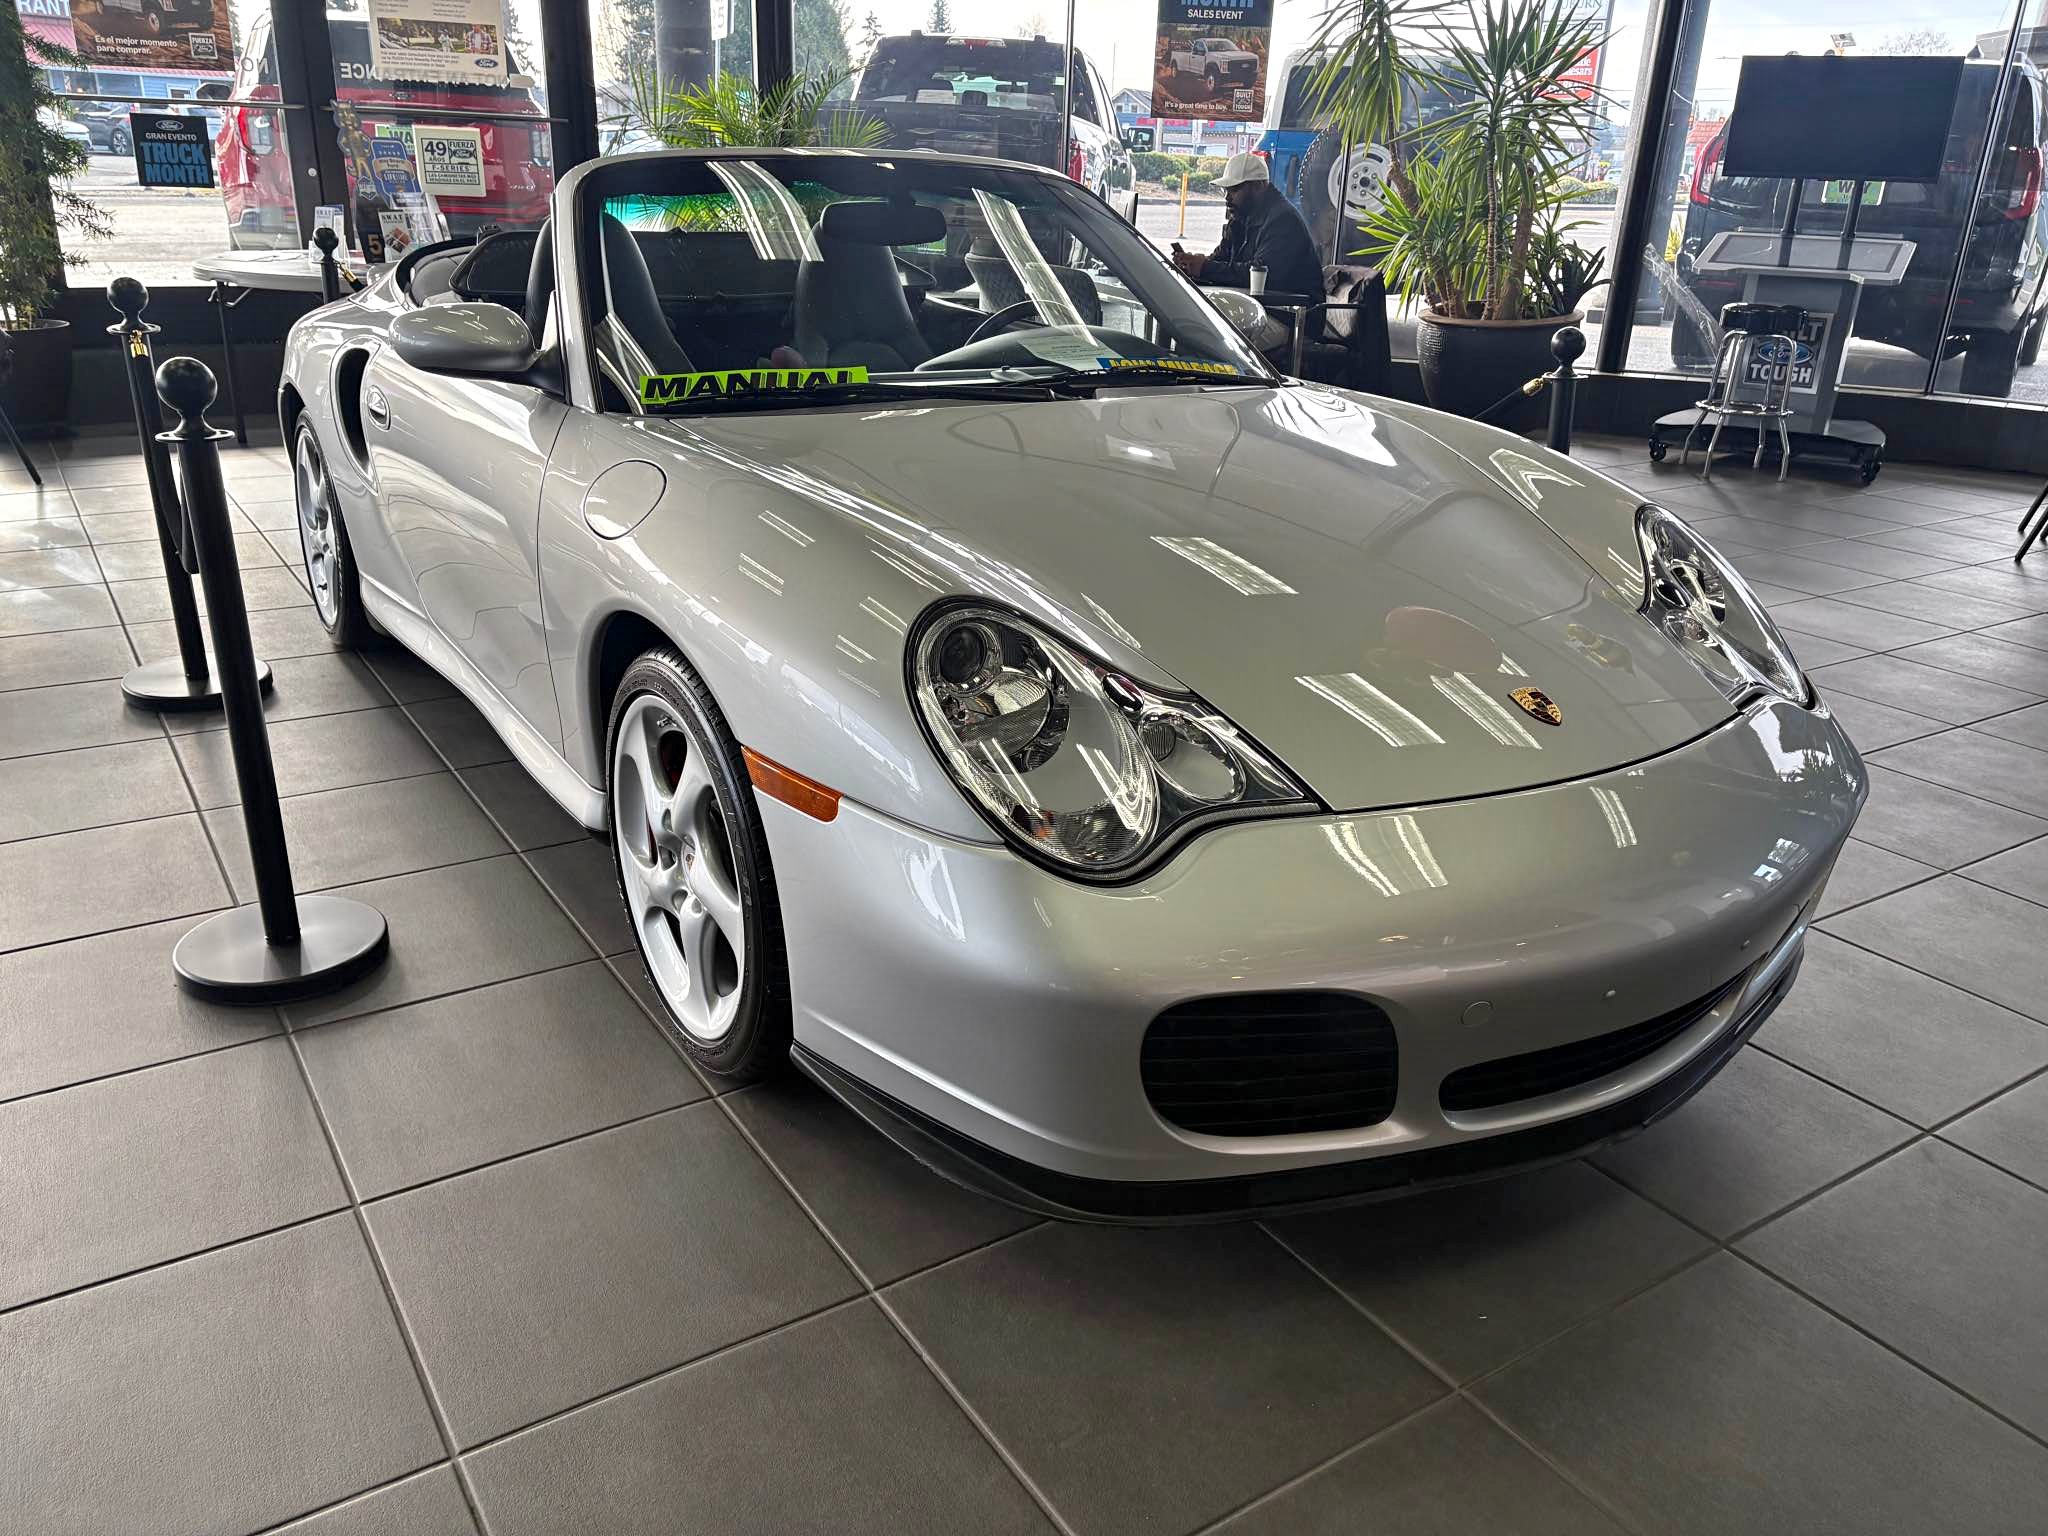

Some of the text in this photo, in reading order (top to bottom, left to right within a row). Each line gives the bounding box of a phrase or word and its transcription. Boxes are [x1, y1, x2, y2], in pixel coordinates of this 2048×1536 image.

[1188, 9, 1243, 20] SALES EVENT
[95, 35, 105, 43] Es
[115, 37, 138, 46] mejor
[140, 39, 178, 48] momento
[96, 46, 115, 54] para
[141, 143, 206, 165] TRUCK
[425, 141, 447, 156] 49
[145, 164, 209, 184] MONTH
[1838, 181, 1872, 194] WY
[1750, 364, 1812, 383] TOUGH
[645, 371, 853, 399] MANUAL
